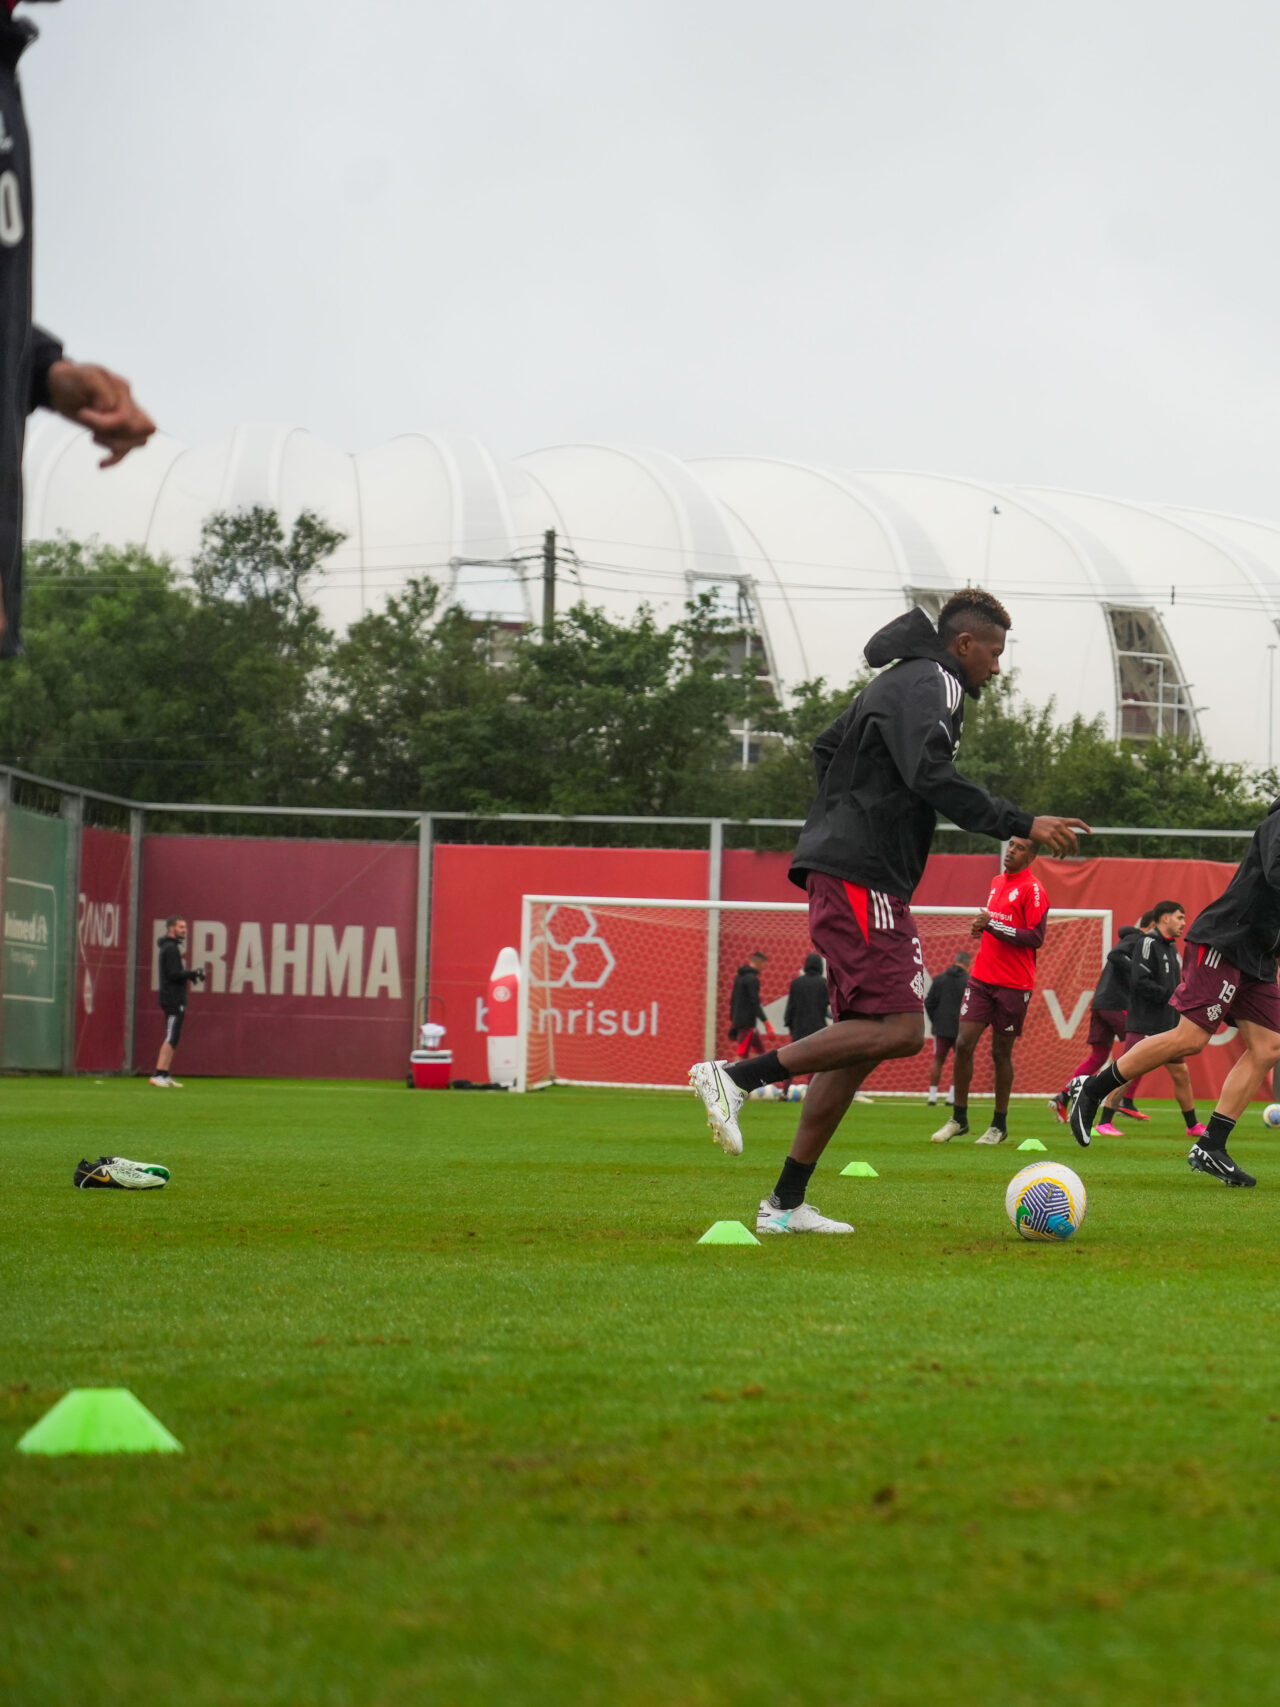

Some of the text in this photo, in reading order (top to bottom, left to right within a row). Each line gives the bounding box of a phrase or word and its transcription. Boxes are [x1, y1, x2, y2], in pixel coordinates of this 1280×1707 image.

[911, 937, 923, 964] 3
[1219, 980, 1236, 1004] 19
[475, 996, 658, 1036] bnrisul
